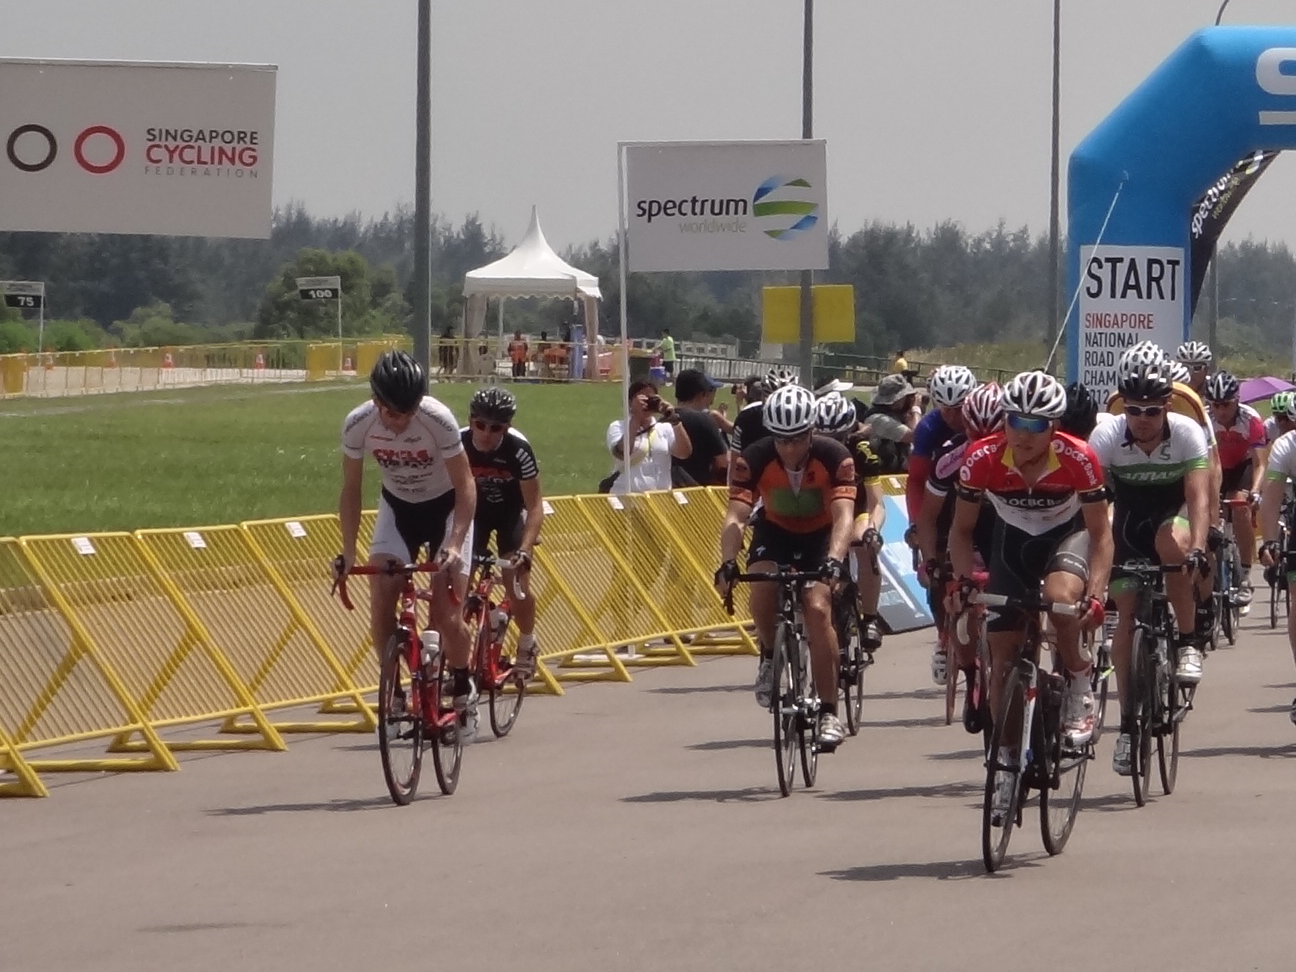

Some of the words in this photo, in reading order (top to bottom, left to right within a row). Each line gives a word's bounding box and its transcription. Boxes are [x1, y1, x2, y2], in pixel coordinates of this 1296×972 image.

[145, 127, 259, 146] SINGAPORE
[145, 143, 258, 167] CYCLING
[144, 166, 258, 179] FEDERATION
[636, 195, 748, 223] spectrum
[678, 218, 747, 234] worldwide
[1085, 256, 1181, 301] START
[17, 296, 35, 307] 75
[308, 289, 333, 299] 100
[1084, 312, 1155, 330] SINGAPORE
[1084, 332, 1140, 348] NATIONAL
[1084, 350, 1115, 367] ROAD
[966, 445, 990, 467] OCBC
[1064, 447, 1090, 466] OCBC
[1083, 461, 1098, 486] Bank
[1008, 497, 1046, 507] OCBC
